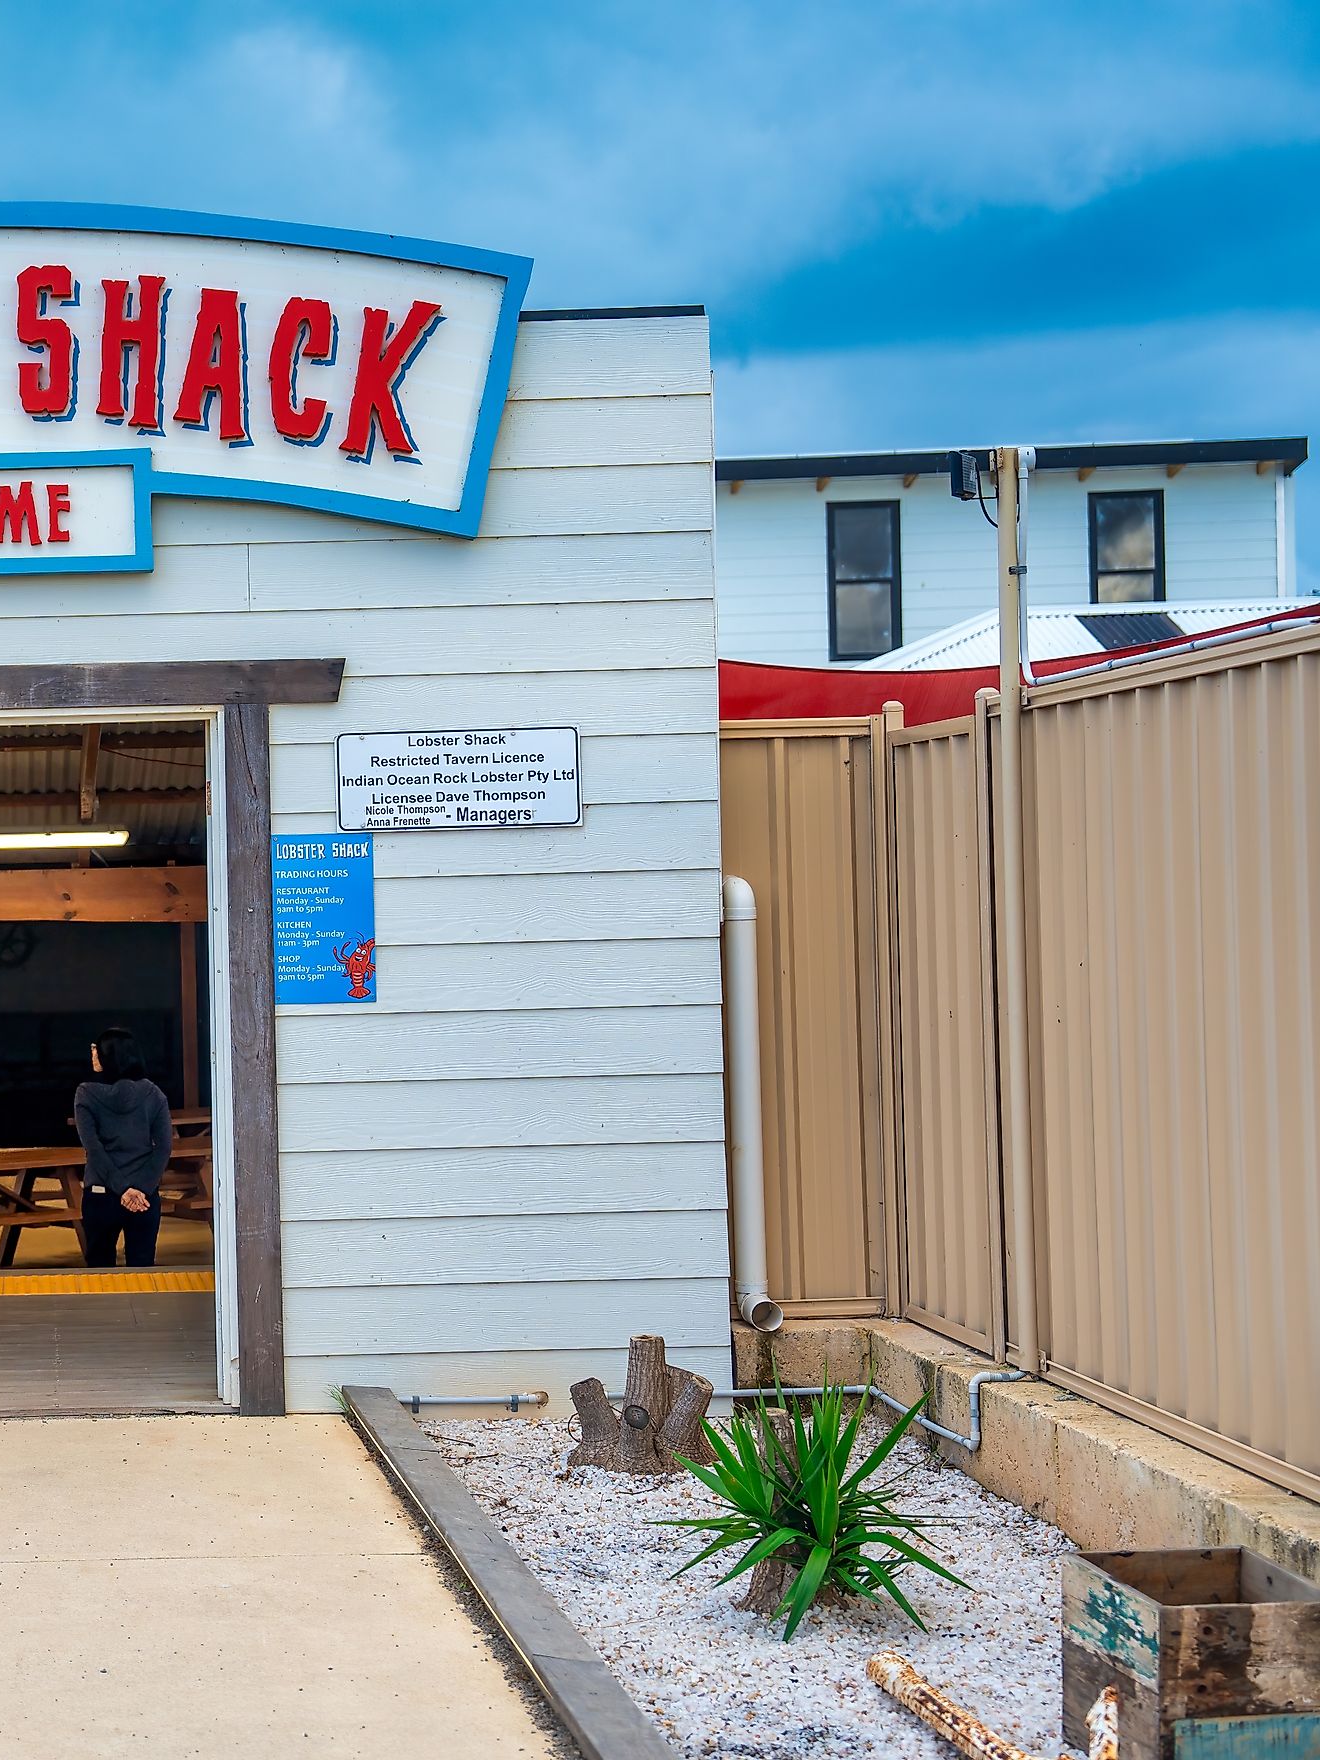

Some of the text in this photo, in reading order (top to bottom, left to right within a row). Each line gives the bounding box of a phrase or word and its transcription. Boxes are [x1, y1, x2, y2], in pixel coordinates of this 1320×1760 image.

[16, 264, 444, 465] SHACK
[408, 733, 506, 747] Lobster Shack
[371, 752, 545, 767] Restricted Tavern Licence
[342, 769, 574, 787] Indian Ocean Rock Lobster Pty Ltd
[372, 789, 545, 805] Licensee Dave Thompson
[366, 804, 446, 815] Nicole Thompson
[457, 806, 532, 824] Managers
[367, 816, 430, 827] Anna Frenette
[277, 842, 369, 860] LOBSTER SHACK
[278, 965, 310, 973] Monday
[278, 974, 295, 982] 9am
